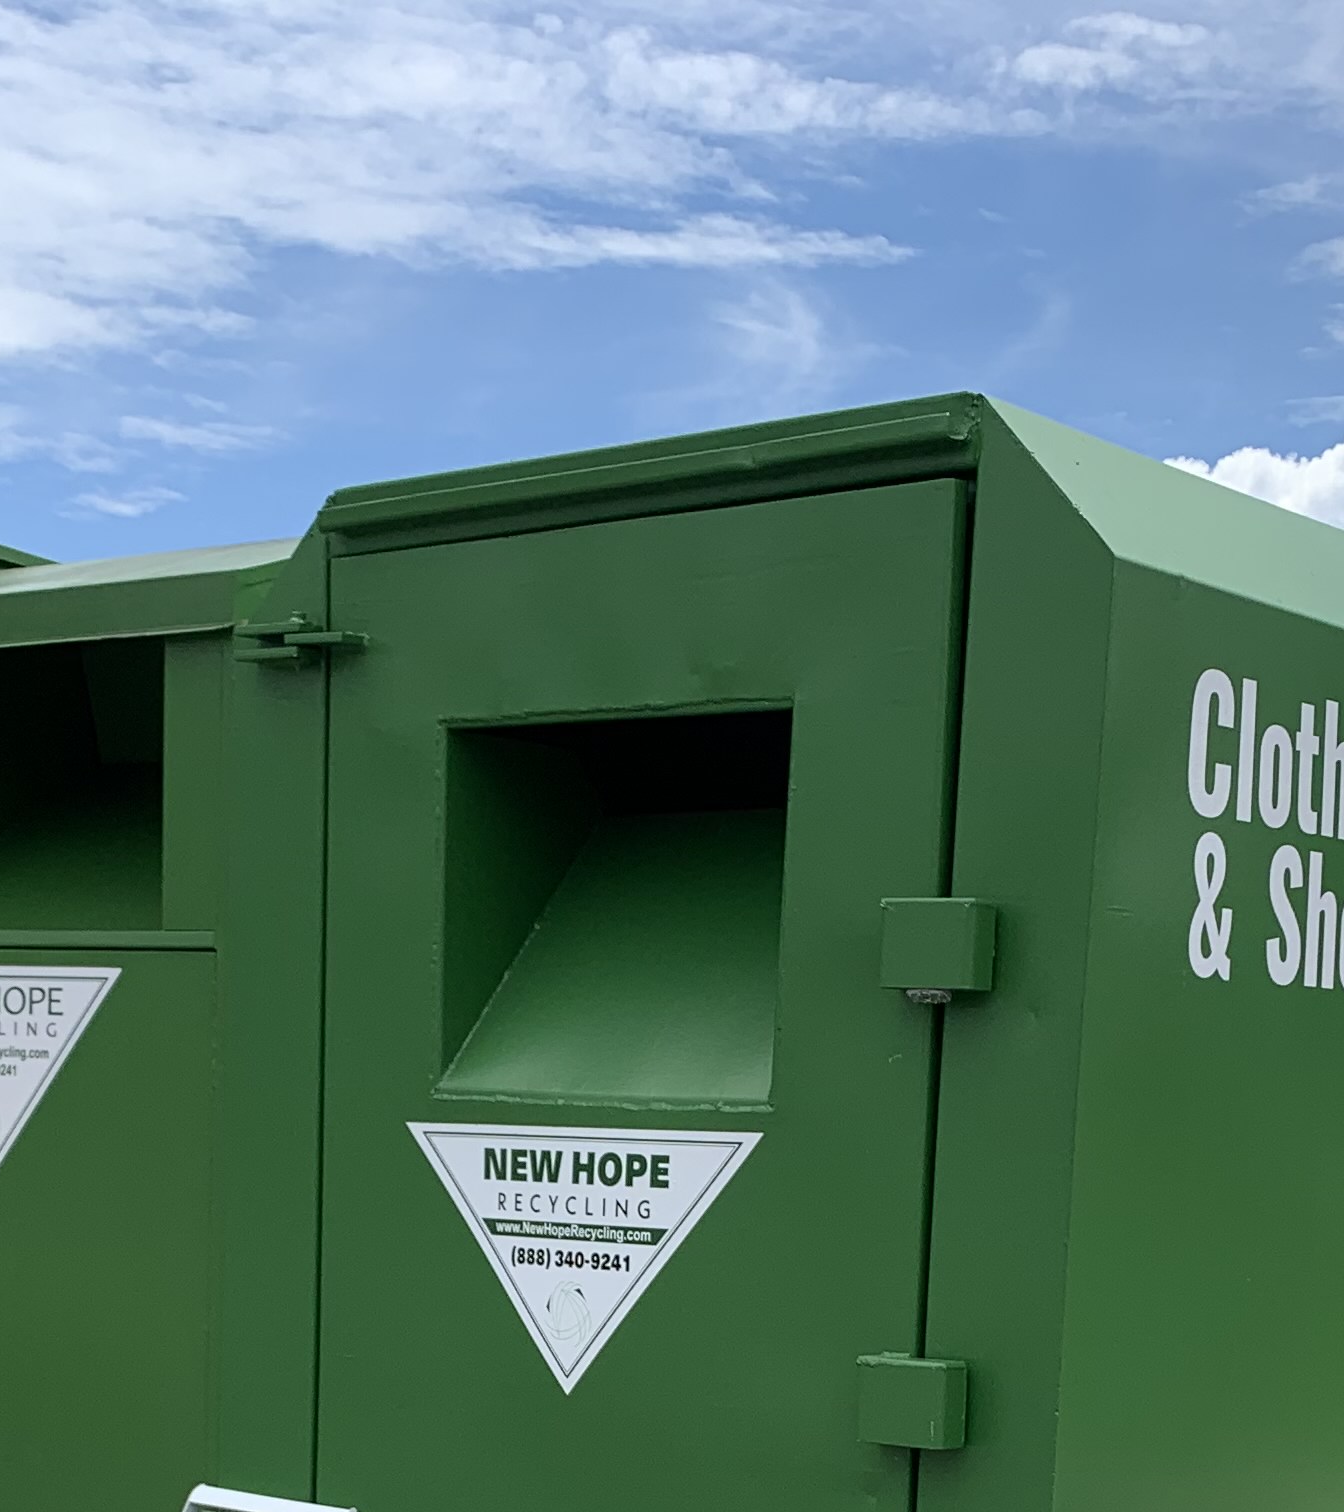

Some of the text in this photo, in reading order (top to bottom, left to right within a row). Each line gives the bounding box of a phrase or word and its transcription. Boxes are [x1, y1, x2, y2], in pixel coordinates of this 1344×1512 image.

[1187, 831, 1234, 982] &
[484, 1147, 671, 1189] NEW HOPE
[498, 1192, 652, 1220] RECYCLING
[495, 1221, 653, 1244] www.NewHopeRecycling.com
[511, 1246, 631, 1273] (888) 340-9241
